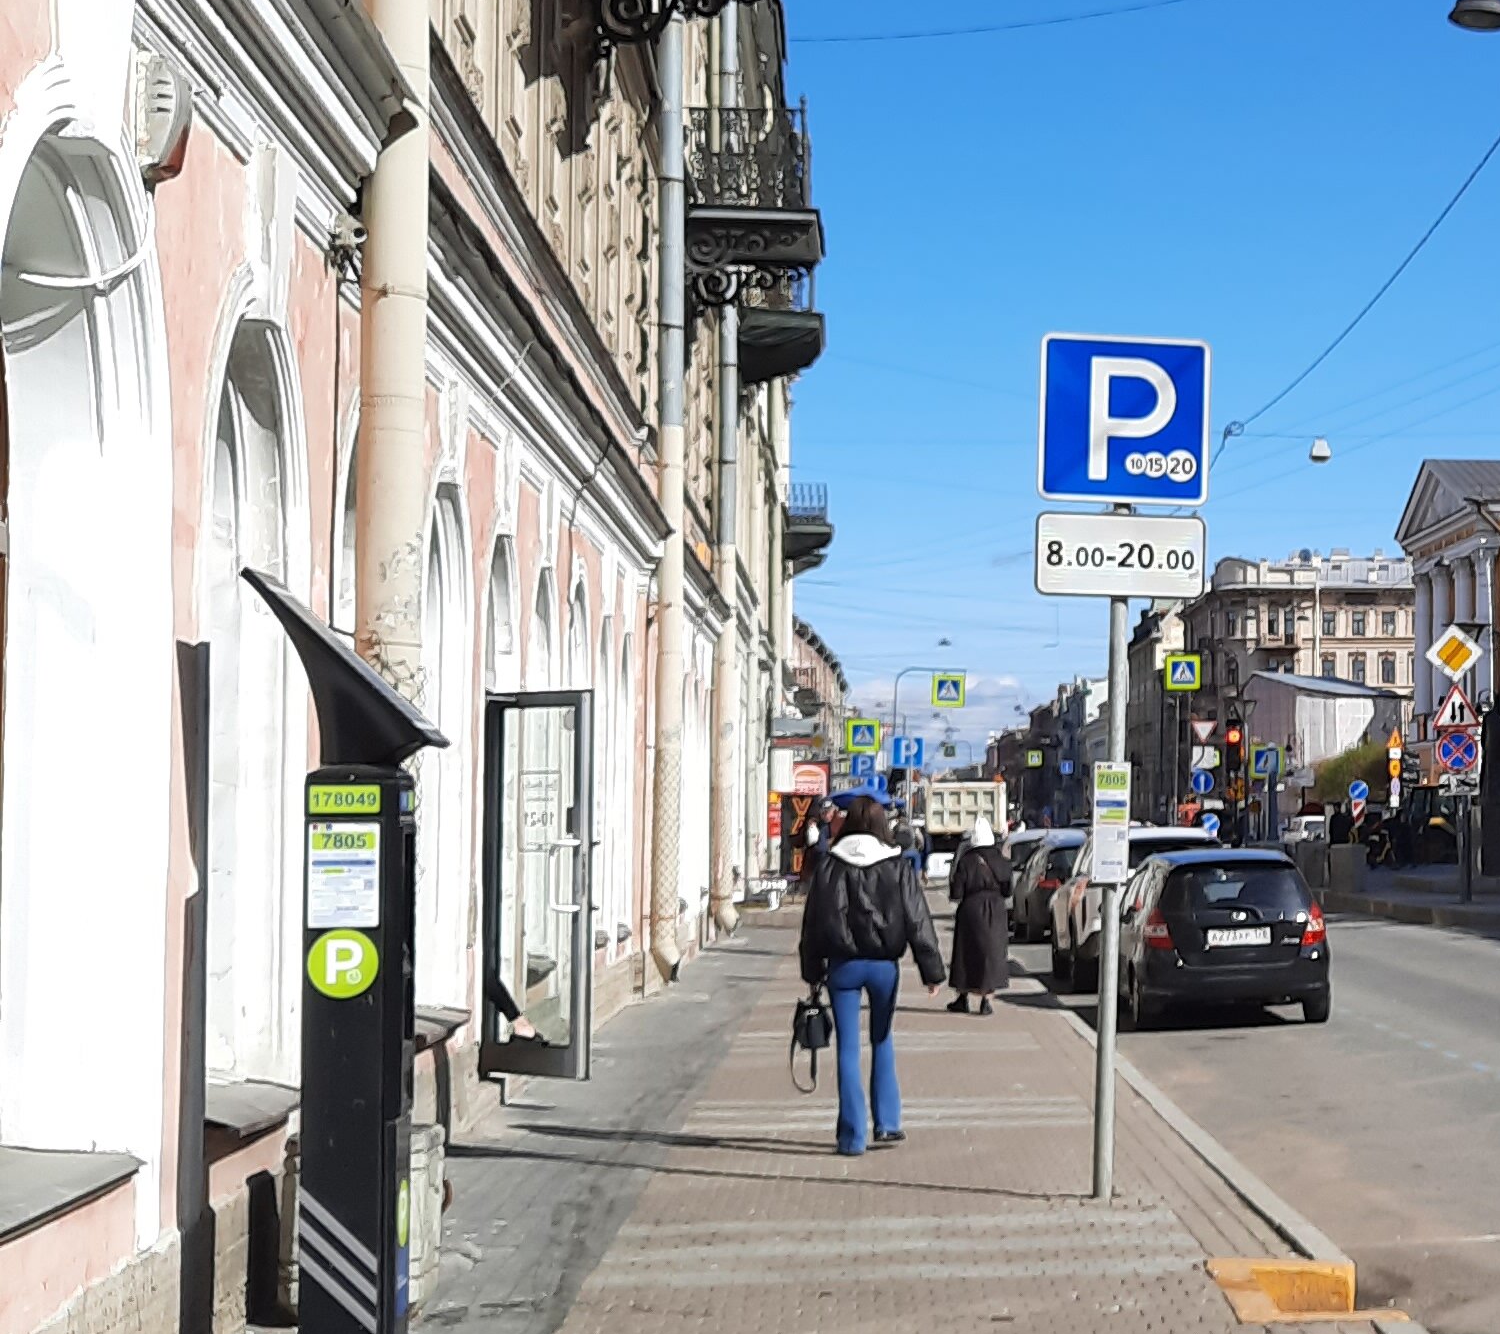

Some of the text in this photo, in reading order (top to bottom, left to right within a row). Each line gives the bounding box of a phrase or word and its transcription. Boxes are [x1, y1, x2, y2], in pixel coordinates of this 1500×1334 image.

[1088, 356, 1177, 481] P
[1130, 458, 1194, 475] 10 15 20
[1046, 540, 1195, 571] 8.00-20.00
[1098, 773, 1127, 786] 7805
[312, 792, 377, 808] 178049
[322, 832, 367, 850] 7805
[325, 938, 364, 985] P
